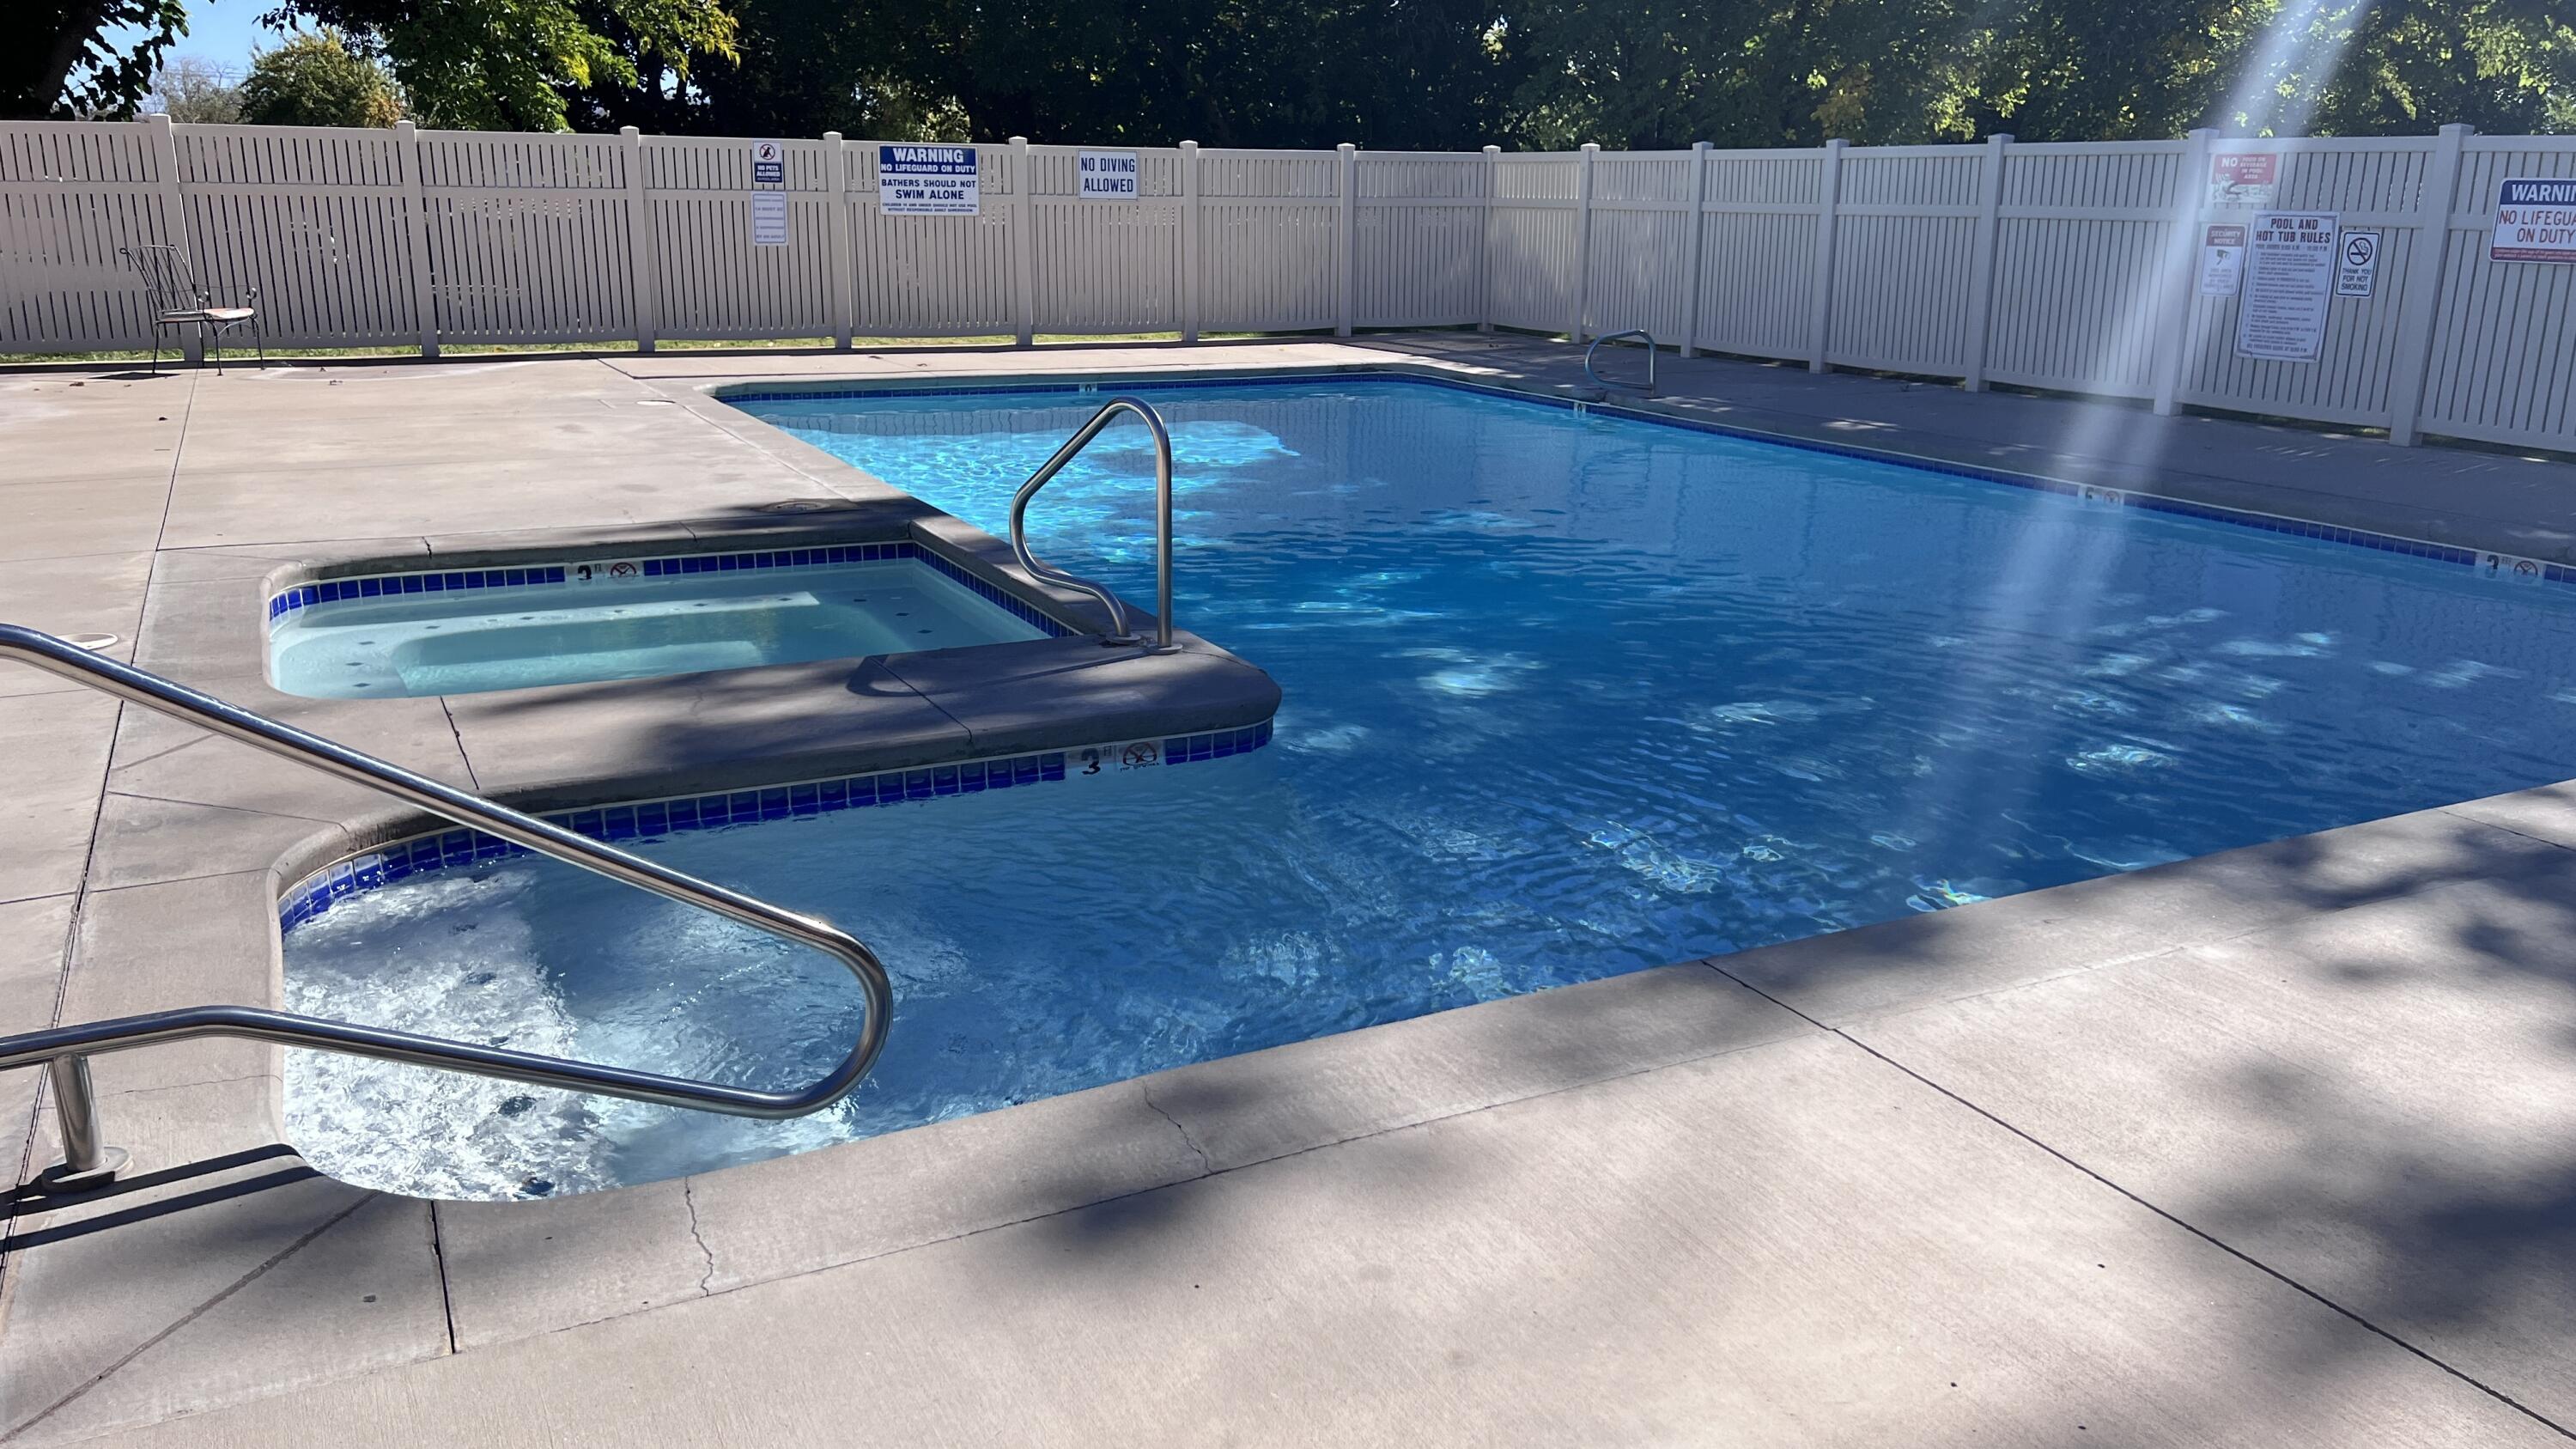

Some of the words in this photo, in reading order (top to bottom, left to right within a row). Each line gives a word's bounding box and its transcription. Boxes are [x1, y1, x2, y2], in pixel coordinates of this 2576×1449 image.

[893, 148, 964, 163] WARNING
[2221, 157, 2238, 167] NO
[881, 163, 892, 172] NO
[896, 164, 939, 173] LIFEGUARD
[955, 165, 975, 174] DUTY
[1081, 157, 1095, 172] NO
[1100, 158, 1135, 173] DIVING
[881, 179, 920, 187] BATHERS
[923, 180, 957, 188] SHOULD
[1084, 177, 1133, 192] ALLOWED
[896, 189, 925, 199] SWIM
[929, 190, 964, 200] ALONE
[2270, 218, 2293, 229] POOL
[2298, 219, 2318, 230] AND
[2499, 210, 2518, 225] NO
[2256, 230, 2274, 241] HOT
[2278, 231, 2296, 242] TUB
[2300, 232, 2330, 244] RULES
[2517, 228, 2536, 243] ON
[2539, 228, 2576, 244] DUTY
[1081, 747, 1101, 775] 3
